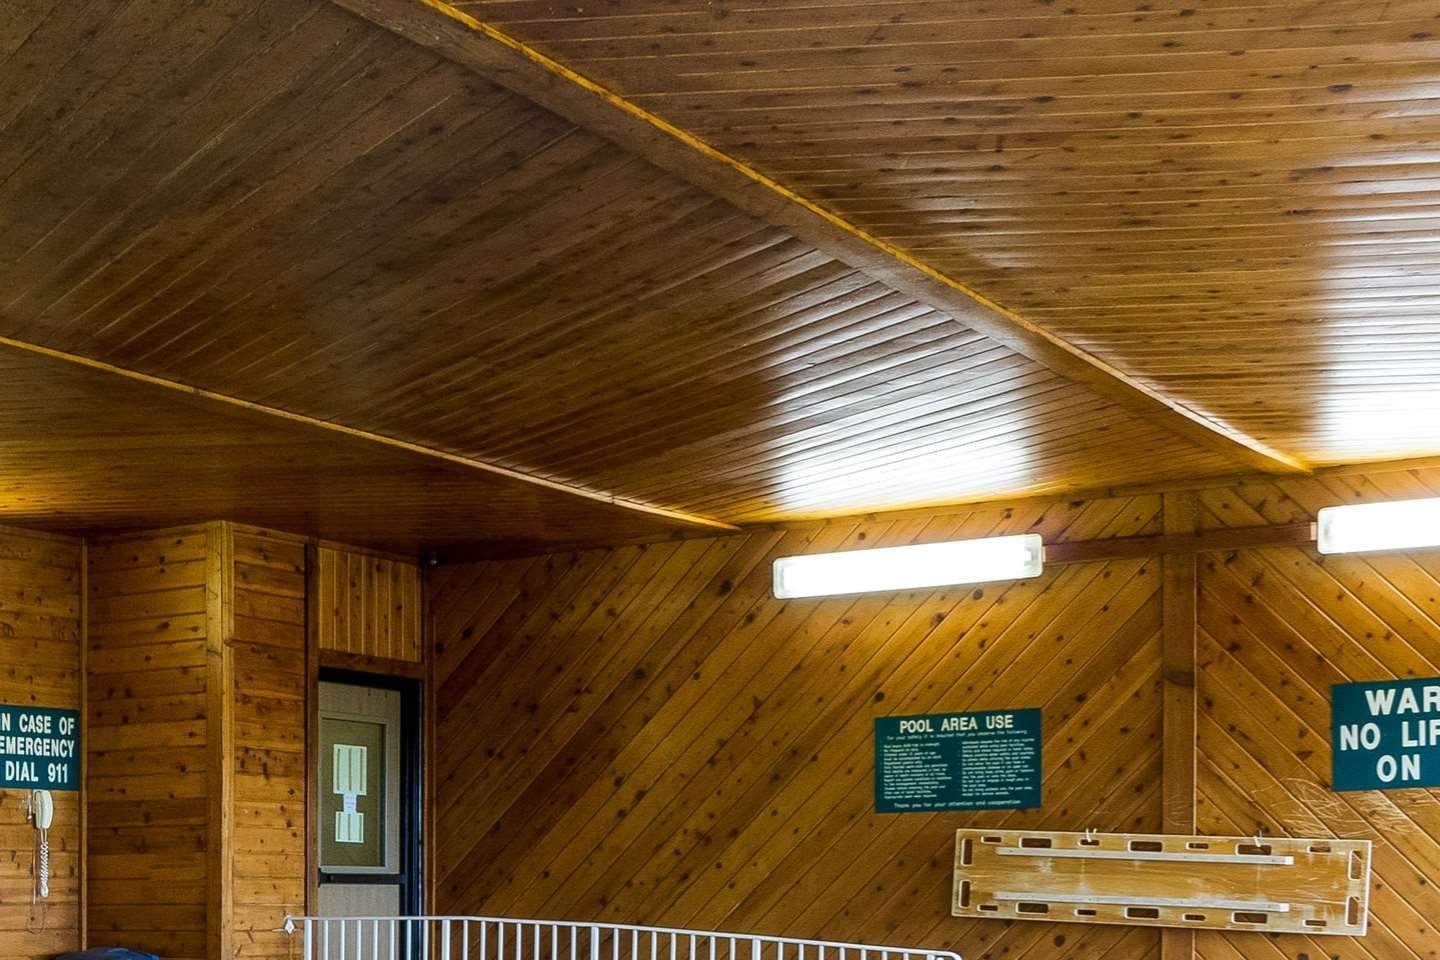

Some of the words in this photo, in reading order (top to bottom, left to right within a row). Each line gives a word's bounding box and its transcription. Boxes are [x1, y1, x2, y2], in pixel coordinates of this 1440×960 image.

[1364, 685, 1440, 716] WAR
[19, 713, 52, 734] CASE
[58, 716, 75, 735] OF
[899, 719, 934, 734] POOL
[940, 716, 978, 731] AREA
[985, 714, 1014, 729] USE
[1340, 722, 1380, 751] NO
[1401, 719, 1440, 748] LIF
[4, 760, 39, 782] DIAL
[47, 762, 68, 784] 911
[1376, 753, 1421, 783] ON
